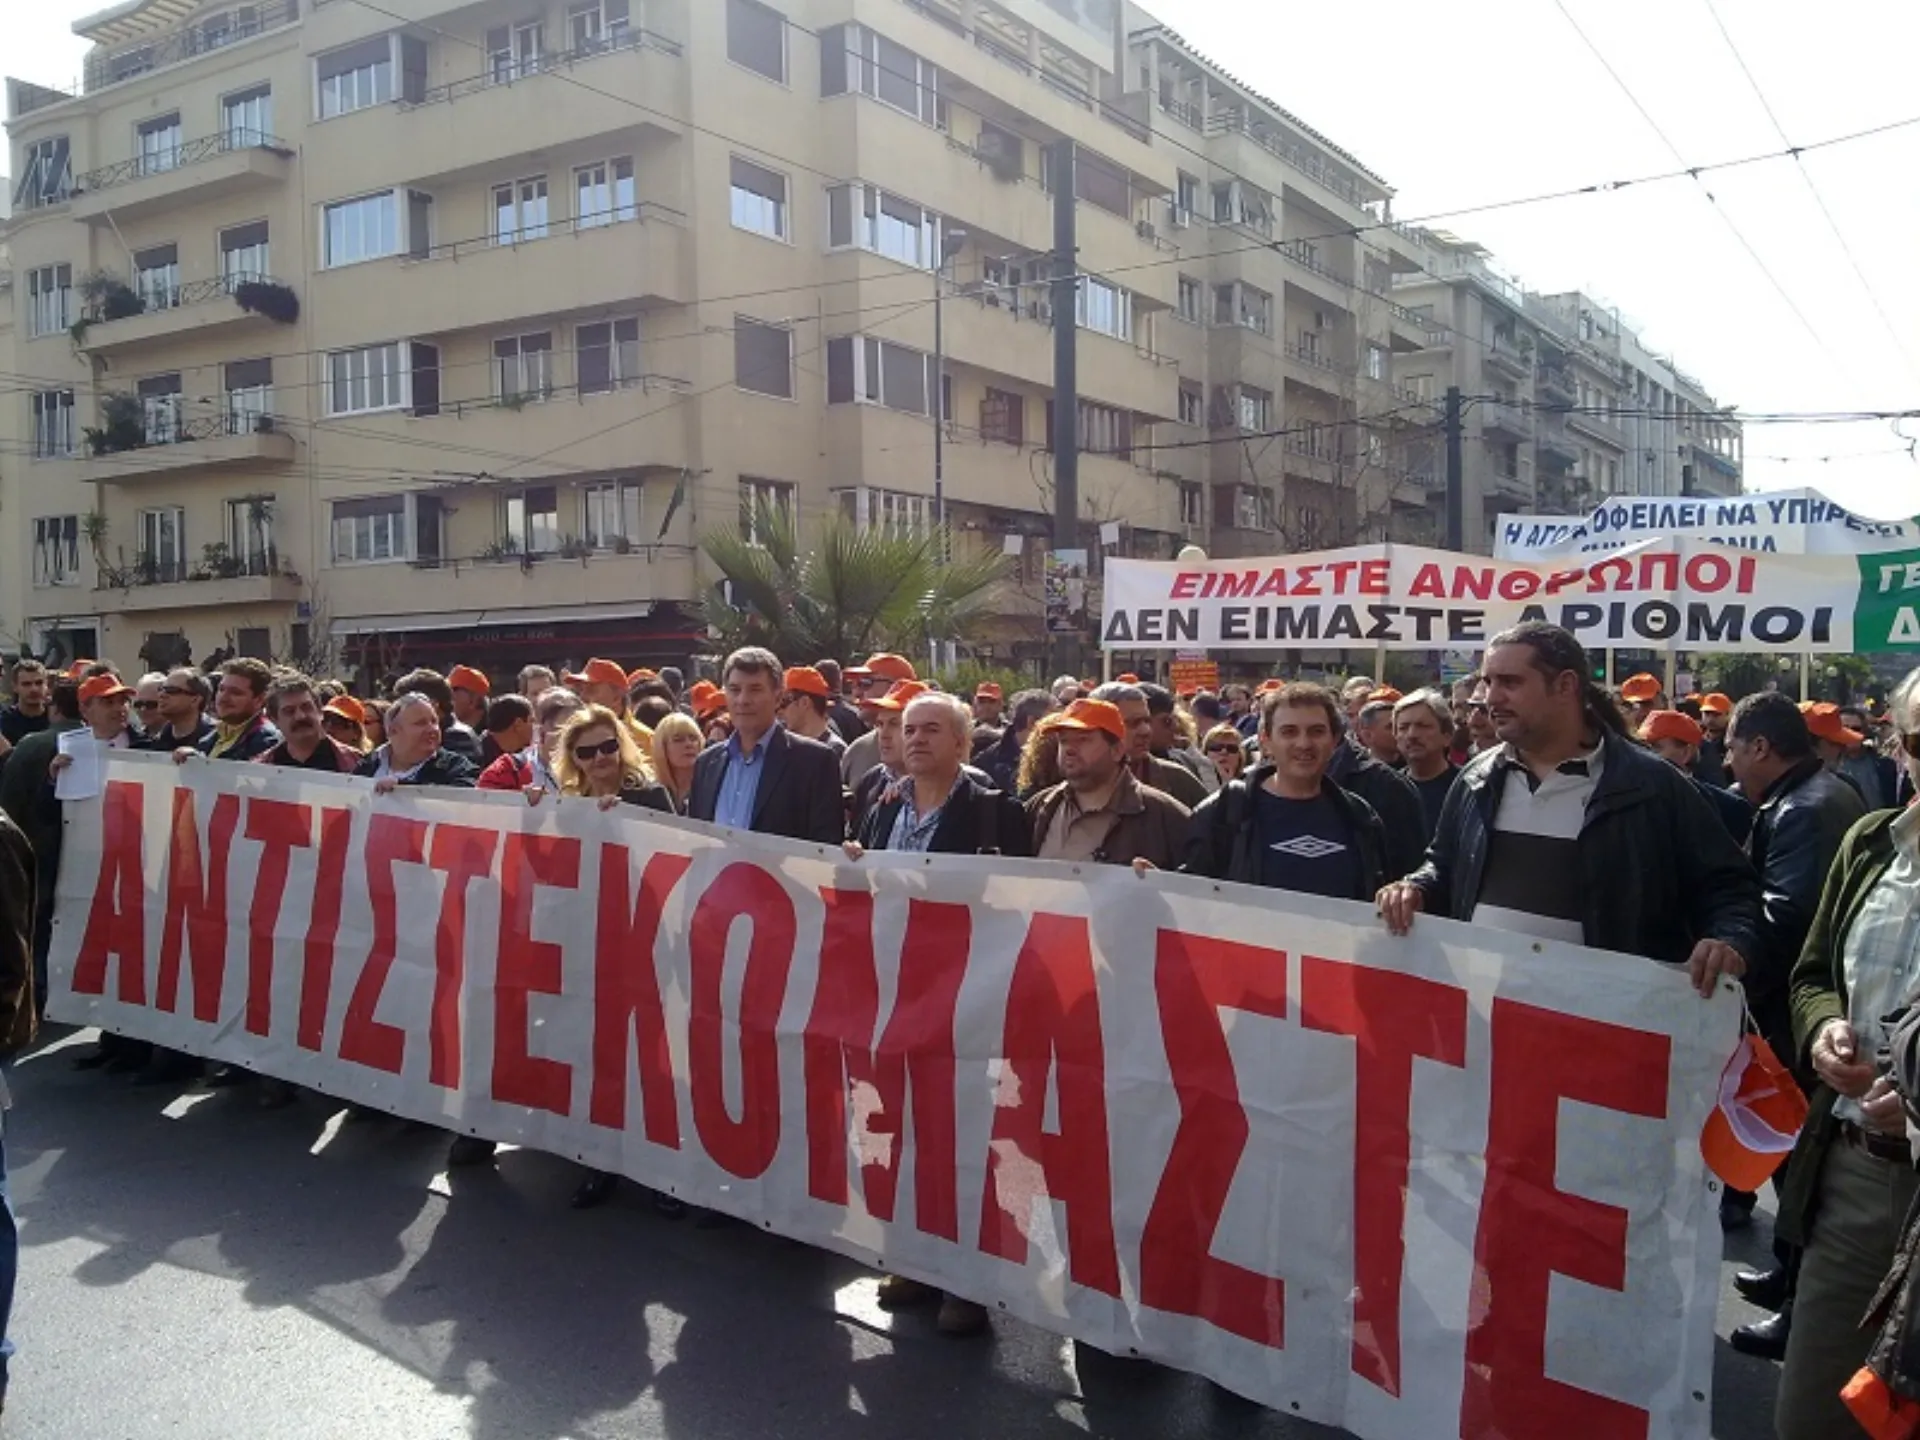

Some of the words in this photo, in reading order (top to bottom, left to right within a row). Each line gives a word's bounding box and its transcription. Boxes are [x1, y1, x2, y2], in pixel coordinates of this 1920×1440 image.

[1505, 522, 1522, 545] Η
[1525, 523, 1588, 547] ΑΓΟΑ
[1593, 503, 1707, 533] ΟΦΕΙΛΕΙ
[1717, 503, 1757, 526] ΝΑ
[1169, 559, 1391, 598] ΕΙΜΑΣΤΕ
[1408, 553, 1756, 601] ΑΝΘΡΩΠΟΙ
[1104, 607, 1199, 641] ΔΕΝ
[1220, 604, 1485, 641] ΕΙΜΑΣΤΕ
[71, 780, 1672, 1440] ΑΝΤΙΣΤΕΚΟΜΑΣΤΕ
